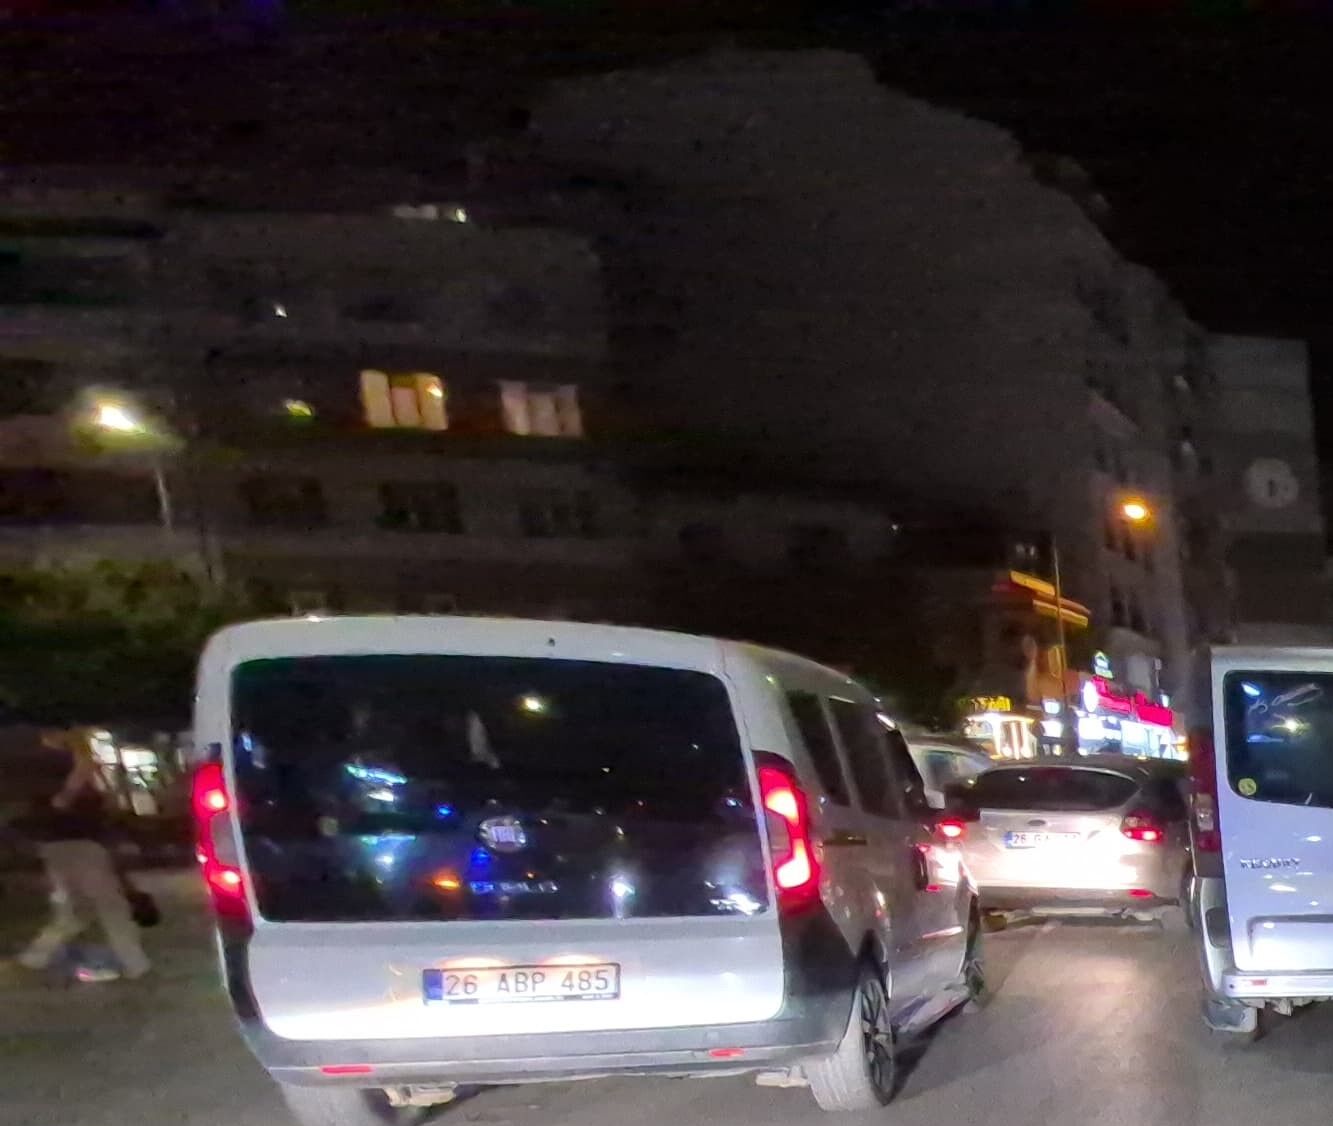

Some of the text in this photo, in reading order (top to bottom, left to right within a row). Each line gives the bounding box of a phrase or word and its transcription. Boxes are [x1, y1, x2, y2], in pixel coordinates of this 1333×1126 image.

[445, 969, 609, 996] 26 ABP 485
